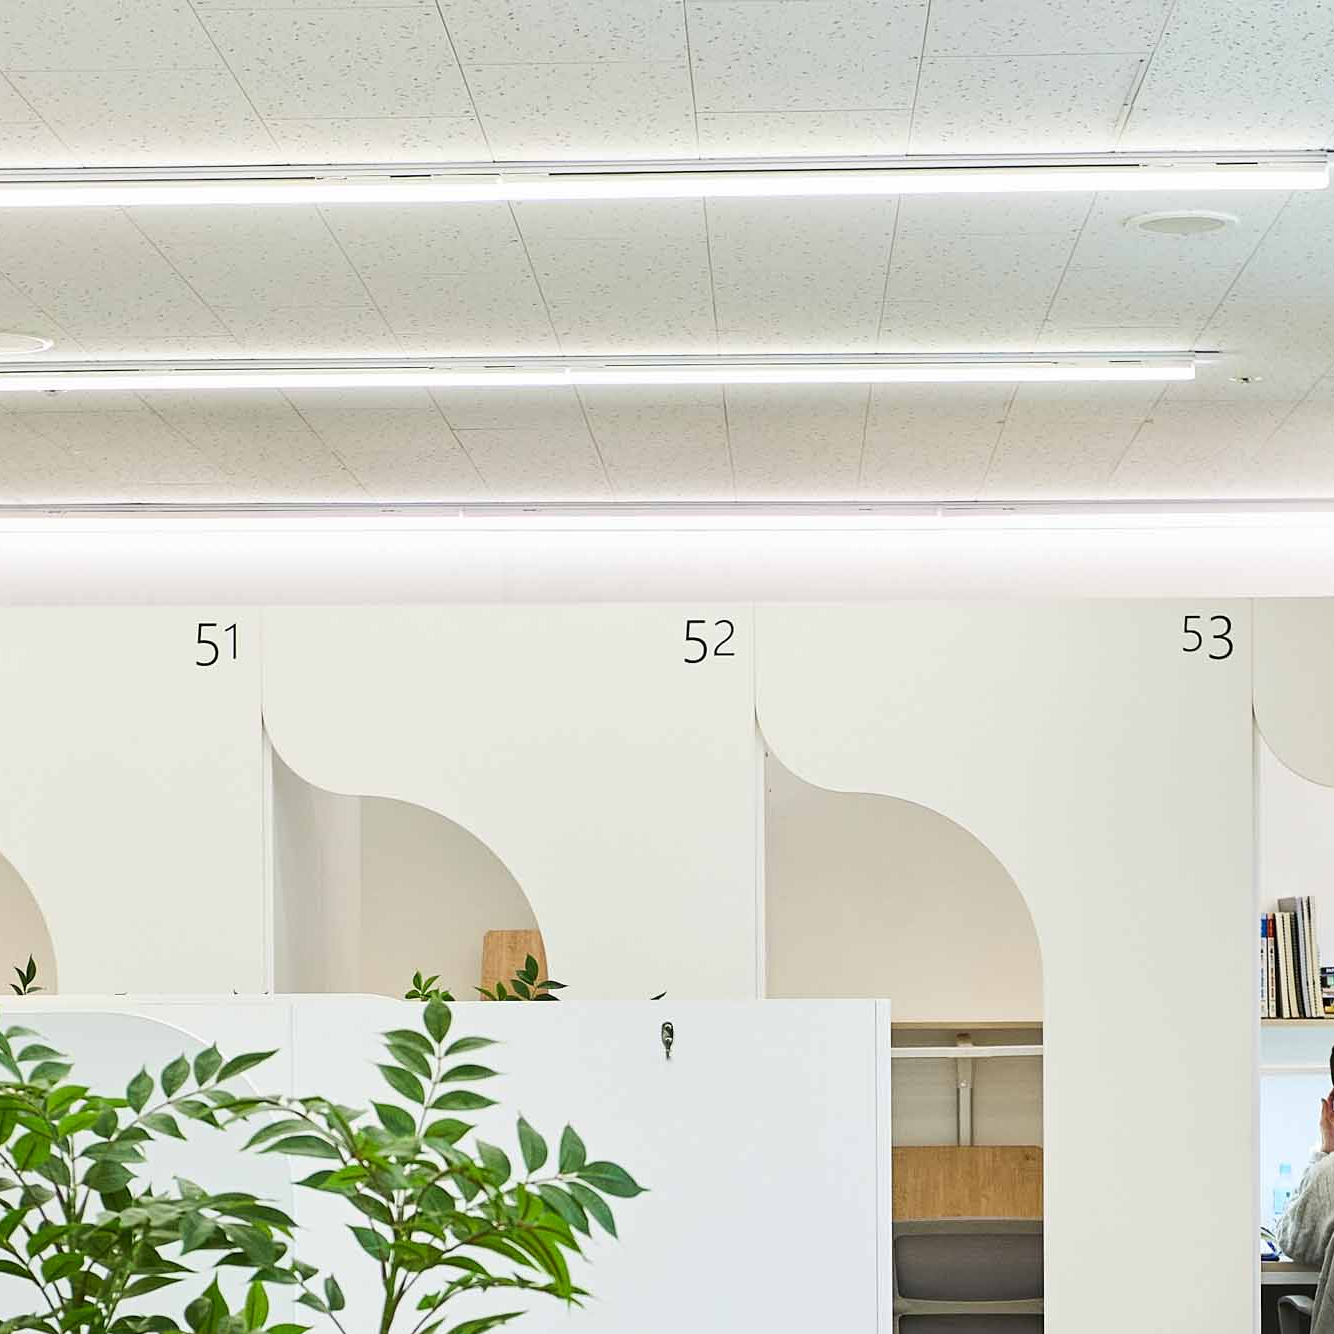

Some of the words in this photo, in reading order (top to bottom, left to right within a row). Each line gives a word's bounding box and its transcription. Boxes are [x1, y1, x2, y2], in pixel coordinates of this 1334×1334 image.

[195, 622, 238, 667] 51
[684, 619, 735, 664] 52
[1181, 615, 1234, 661] 53
